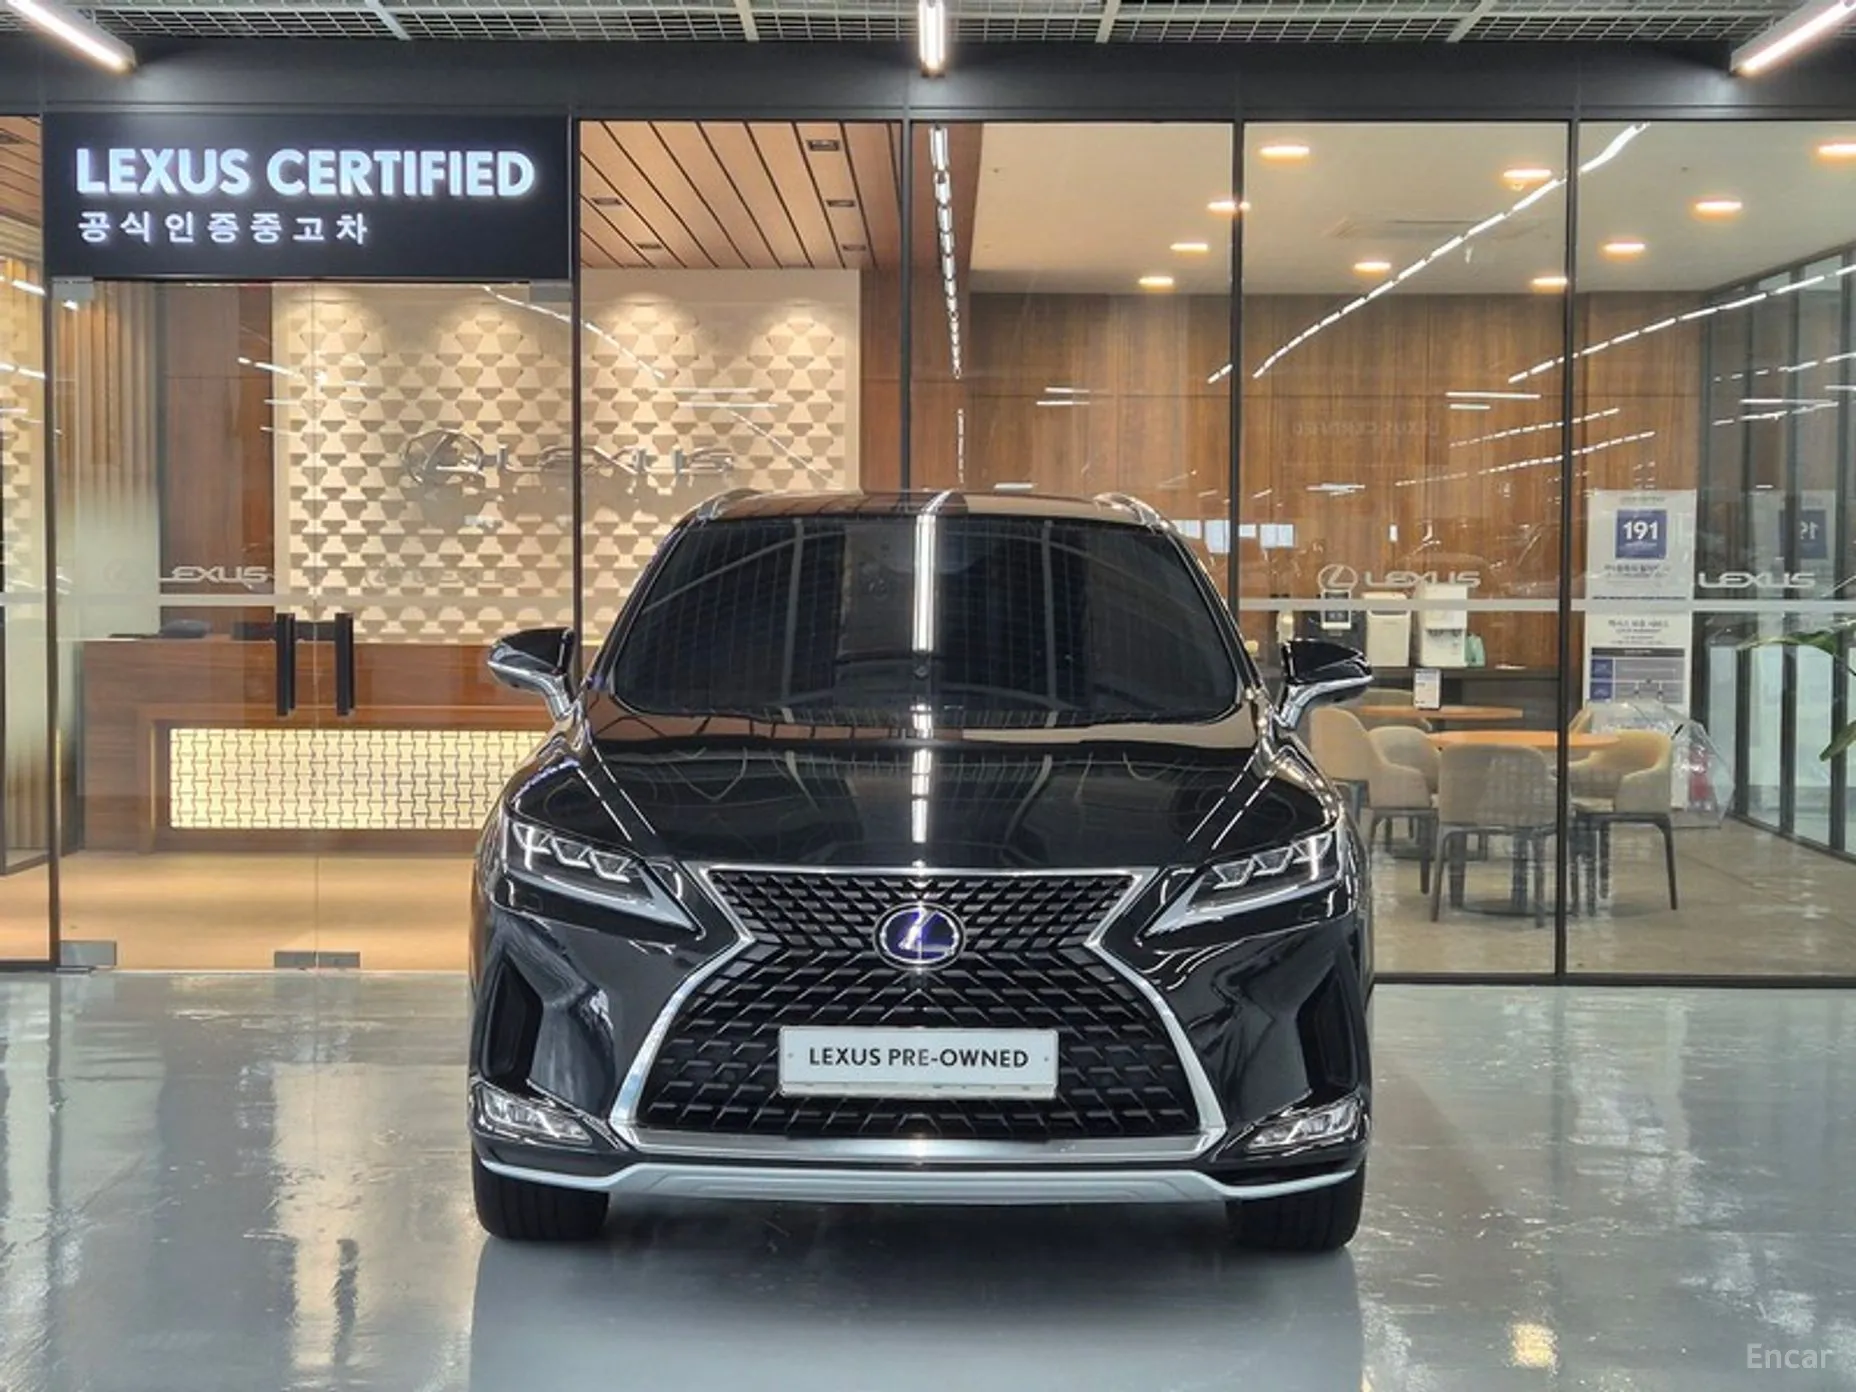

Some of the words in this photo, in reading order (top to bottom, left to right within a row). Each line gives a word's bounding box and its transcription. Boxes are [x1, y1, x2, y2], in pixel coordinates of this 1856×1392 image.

[76, 148, 249, 194] LEXUS
[267, 149, 536, 197] CERTIFIED
[77, 211, 368, 245] 공식인증중고차
[1623, 520, 1658, 541] 191
[1363, 571, 1481, 588] LEXUS
[1698, 571, 1815, 589] LEXUS
[809, 1047, 881, 1066] LEXUS
[888, 1048, 1029, 1068] PRE-OWNED
